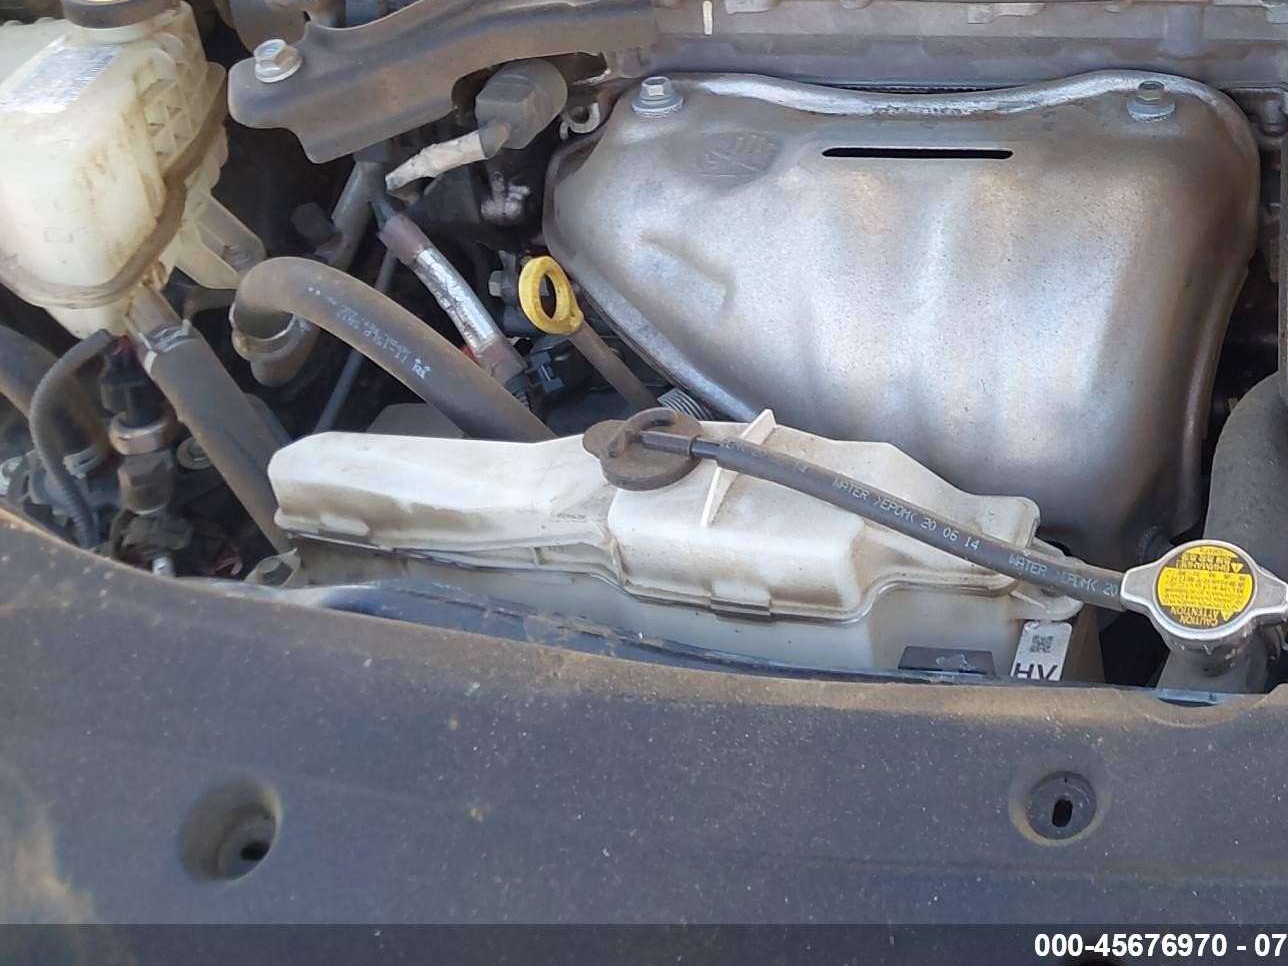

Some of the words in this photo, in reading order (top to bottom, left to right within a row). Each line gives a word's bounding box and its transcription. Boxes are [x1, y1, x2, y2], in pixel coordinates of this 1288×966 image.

[832, 477, 869, 501] WATER
[920, 517, 937, 531] 20
[942, 527, 960, 541] 06
[963, 536, 980, 551] 14
[1008, 554, 1048, 577] WATER
[1102, 583, 1119, 597] 20
[1170, 606, 1220, 617] ATTENTION
[1179, 615, 1218, 626] CAUTION
[1014, 662, 1058, 681] HV
